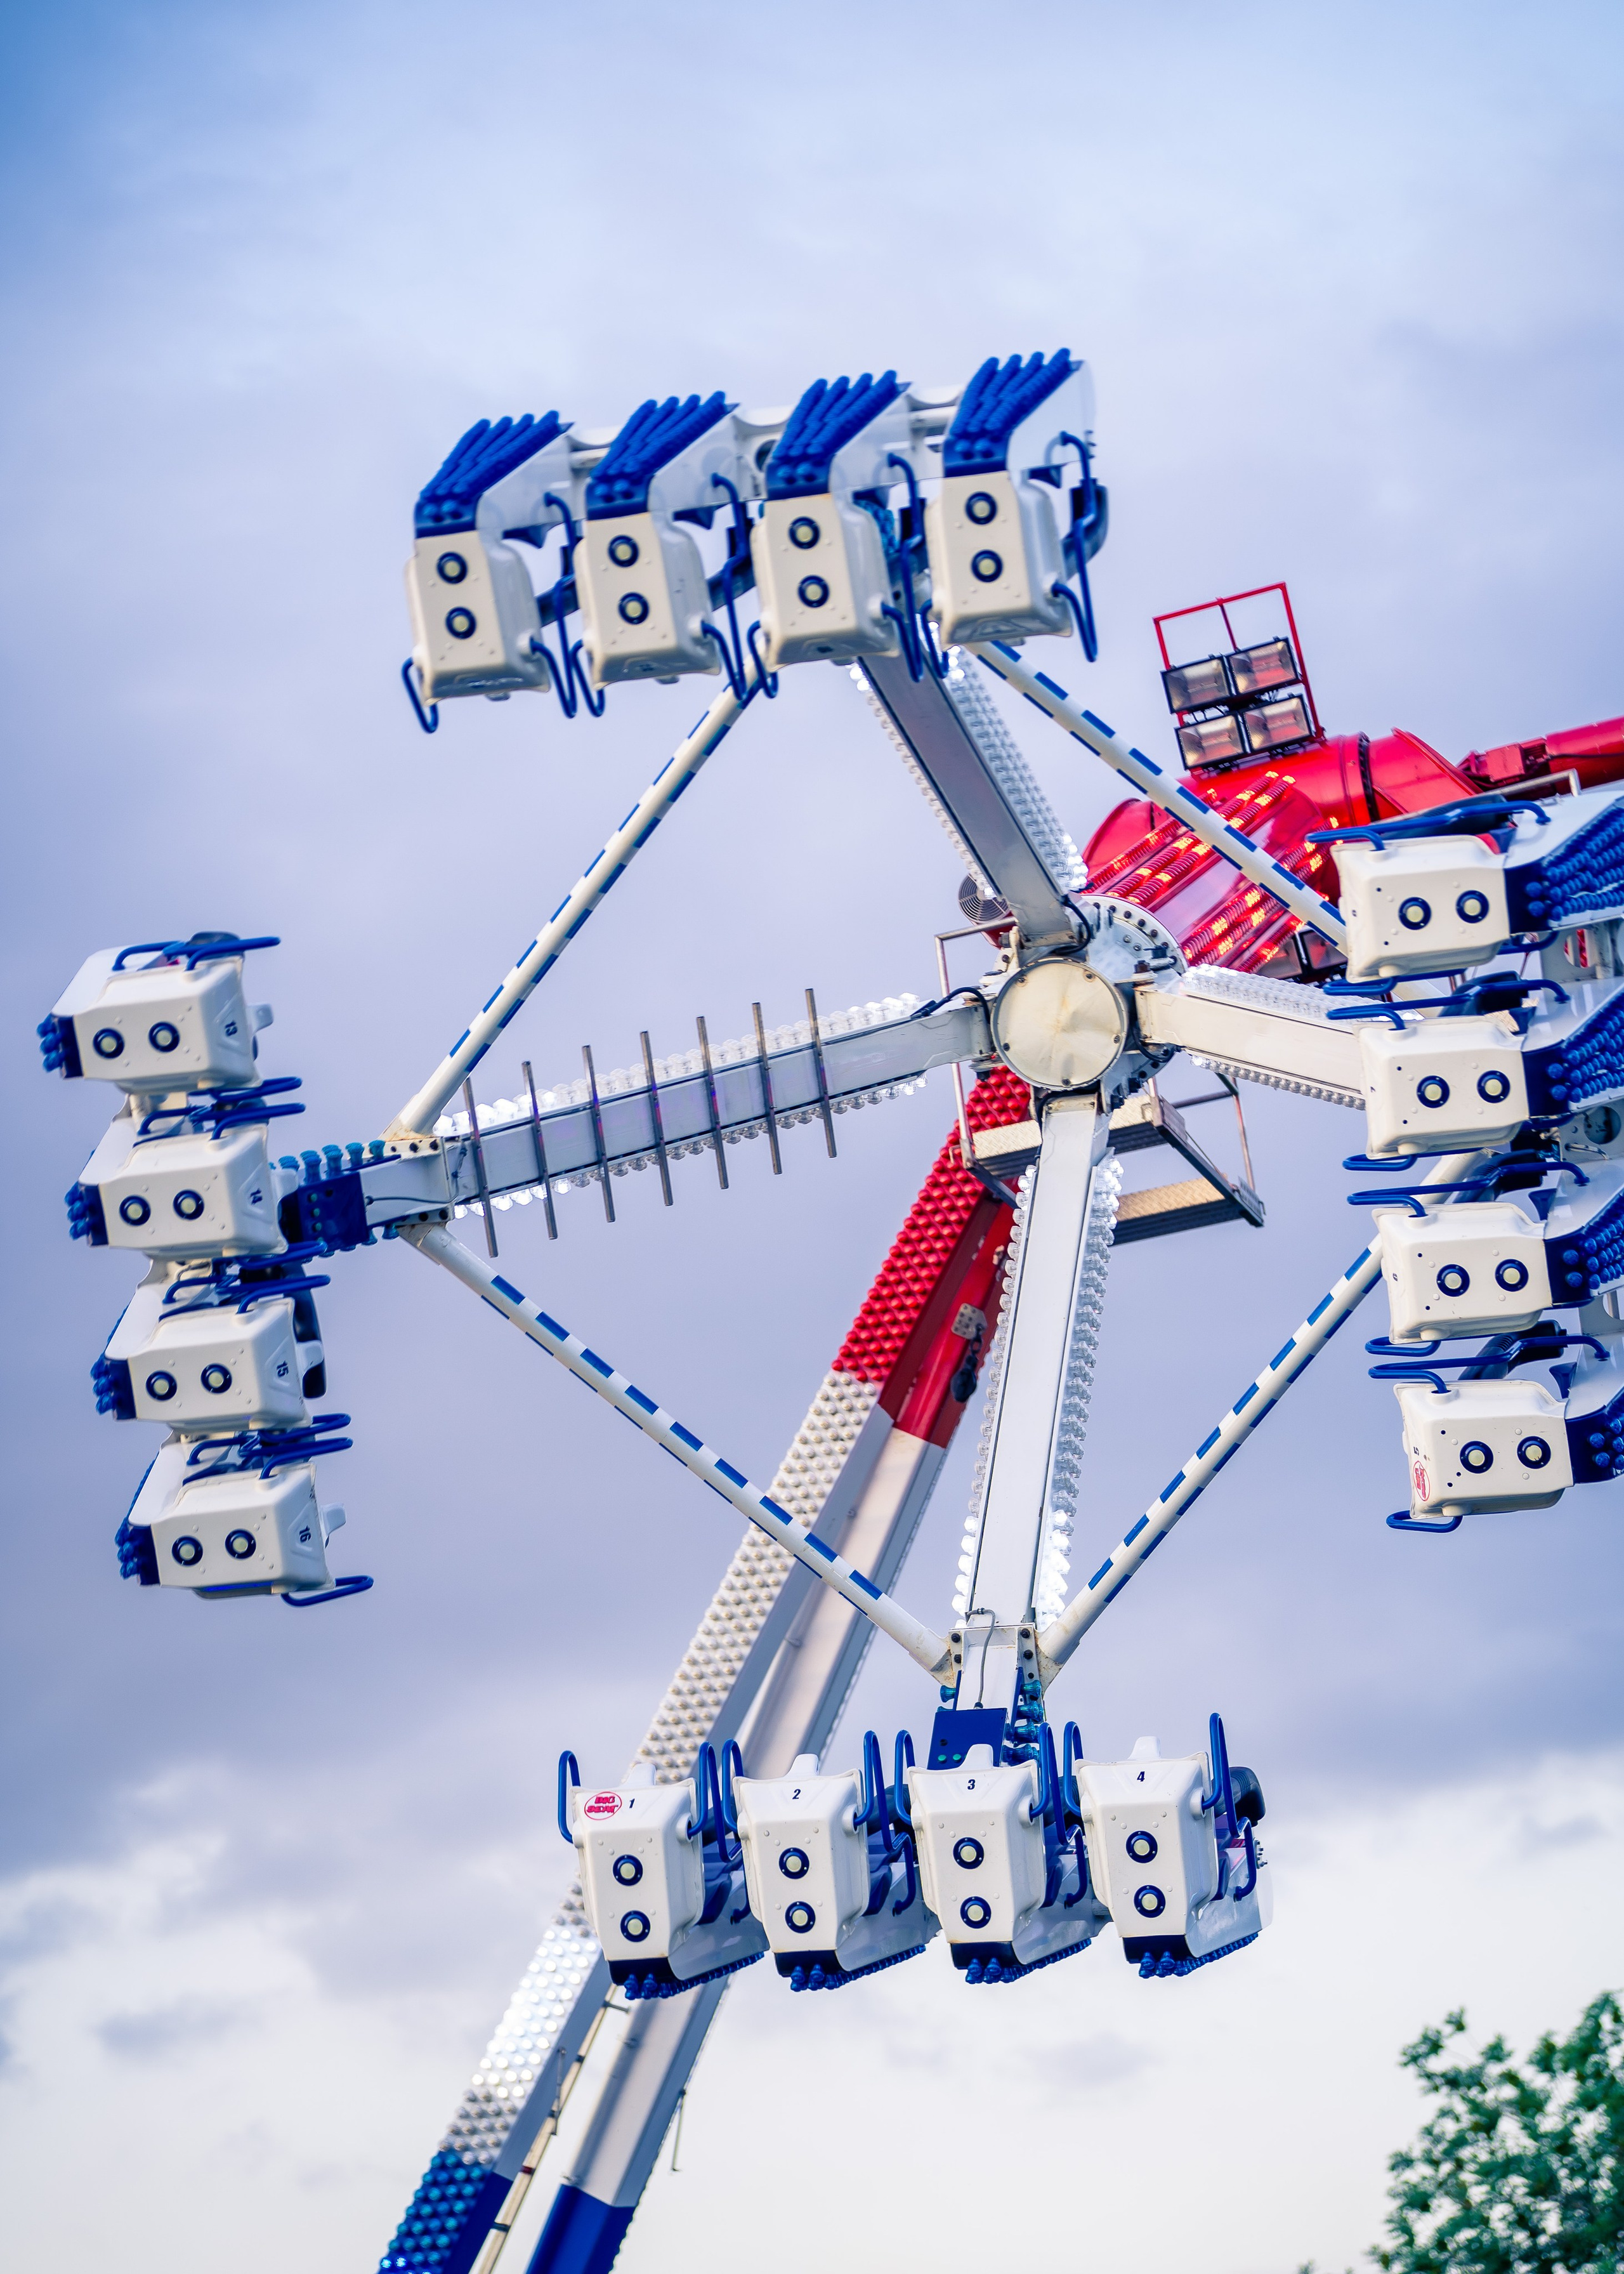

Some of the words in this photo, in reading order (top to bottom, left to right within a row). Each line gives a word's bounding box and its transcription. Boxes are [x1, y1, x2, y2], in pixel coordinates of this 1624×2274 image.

[225, 1020, 238, 1037] 13
[250, 1188, 263, 1206] 14
[277, 1360, 289, 1377] 15
[1413, 1446, 1420, 1456] 5
[299, 1525, 311, 1543] 16
[1137, 1771, 1145, 1782] 4
[967, 1778, 976, 1790] 3
[792, 1789, 801, 1799] 2
[629, 1798, 635, 1808] 1
